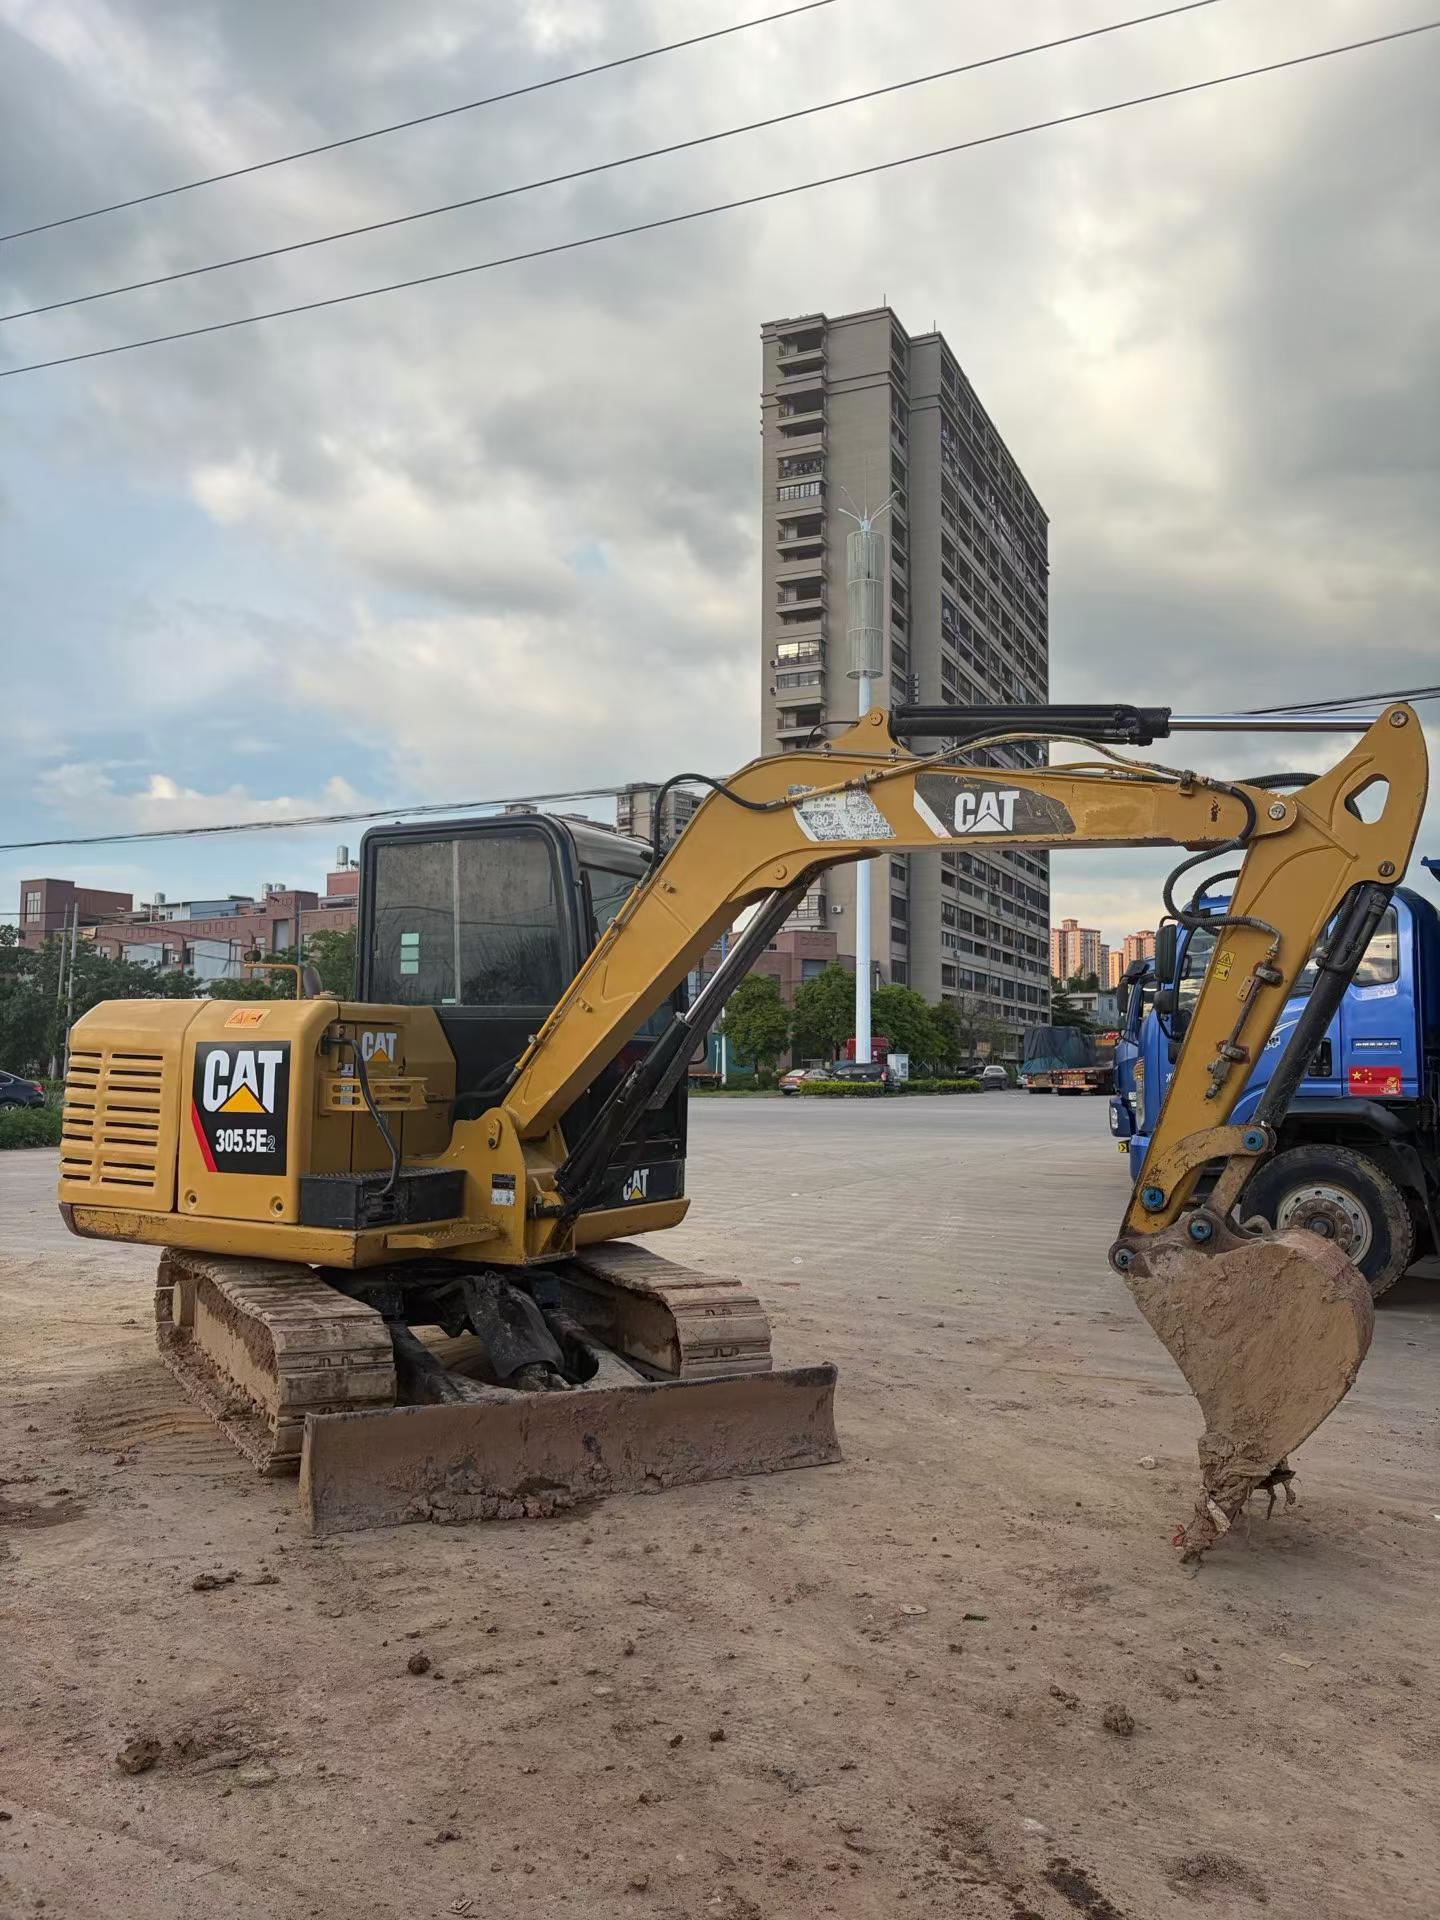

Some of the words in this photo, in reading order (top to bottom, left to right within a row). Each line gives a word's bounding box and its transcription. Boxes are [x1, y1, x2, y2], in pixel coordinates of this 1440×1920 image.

[954, 791, 1020, 832] CAT
[362, 1032, 397, 1063] CAT
[203, 1050, 283, 1113] CAT
[215, 1128, 275, 1153] 305.5E2
